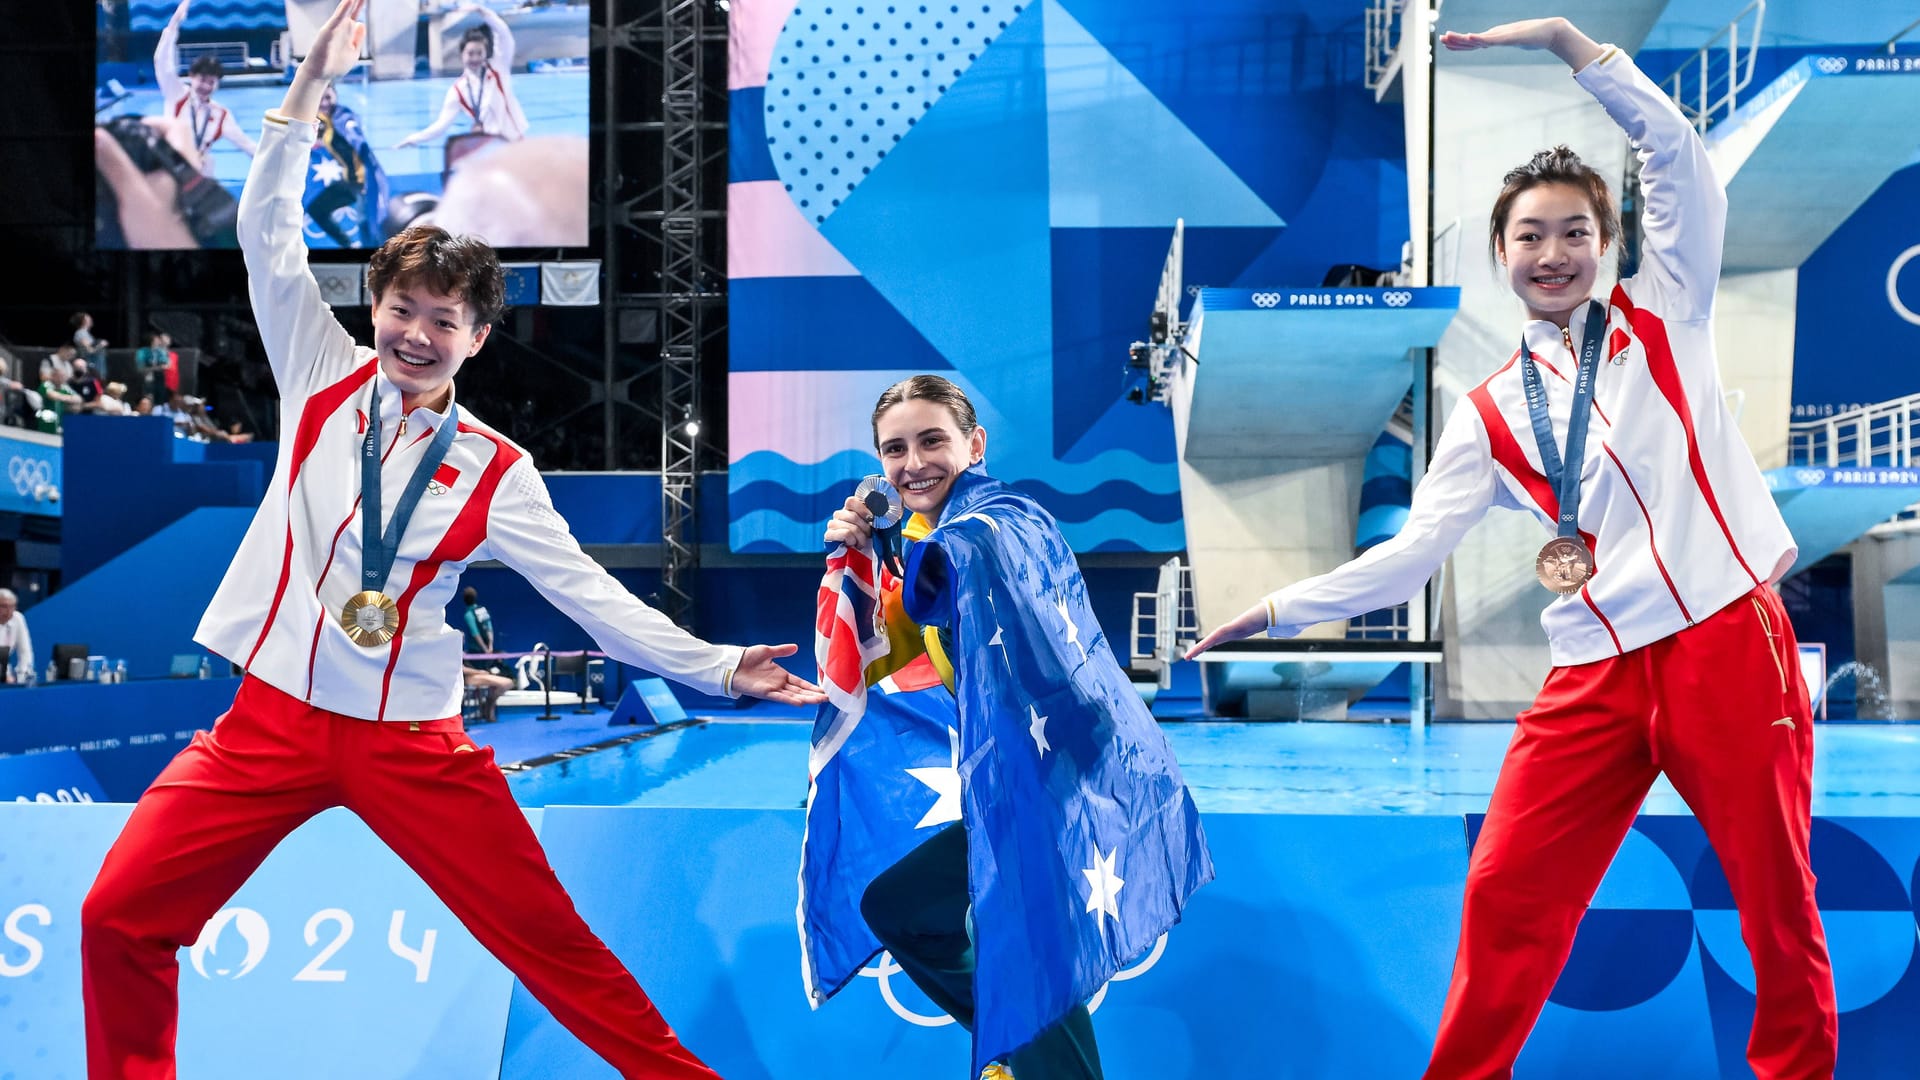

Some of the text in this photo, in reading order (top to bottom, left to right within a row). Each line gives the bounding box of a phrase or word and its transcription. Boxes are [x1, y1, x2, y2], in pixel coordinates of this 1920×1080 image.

[1855, 58, 1901, 71] PARIS
[1290, 293, 1374, 305] PARIS 2024
[1578, 339, 1595, 394] PARIS 2024
[1528, 384, 1539, 409] PARIS
[1833, 471, 1918, 484] PARIS 2024
